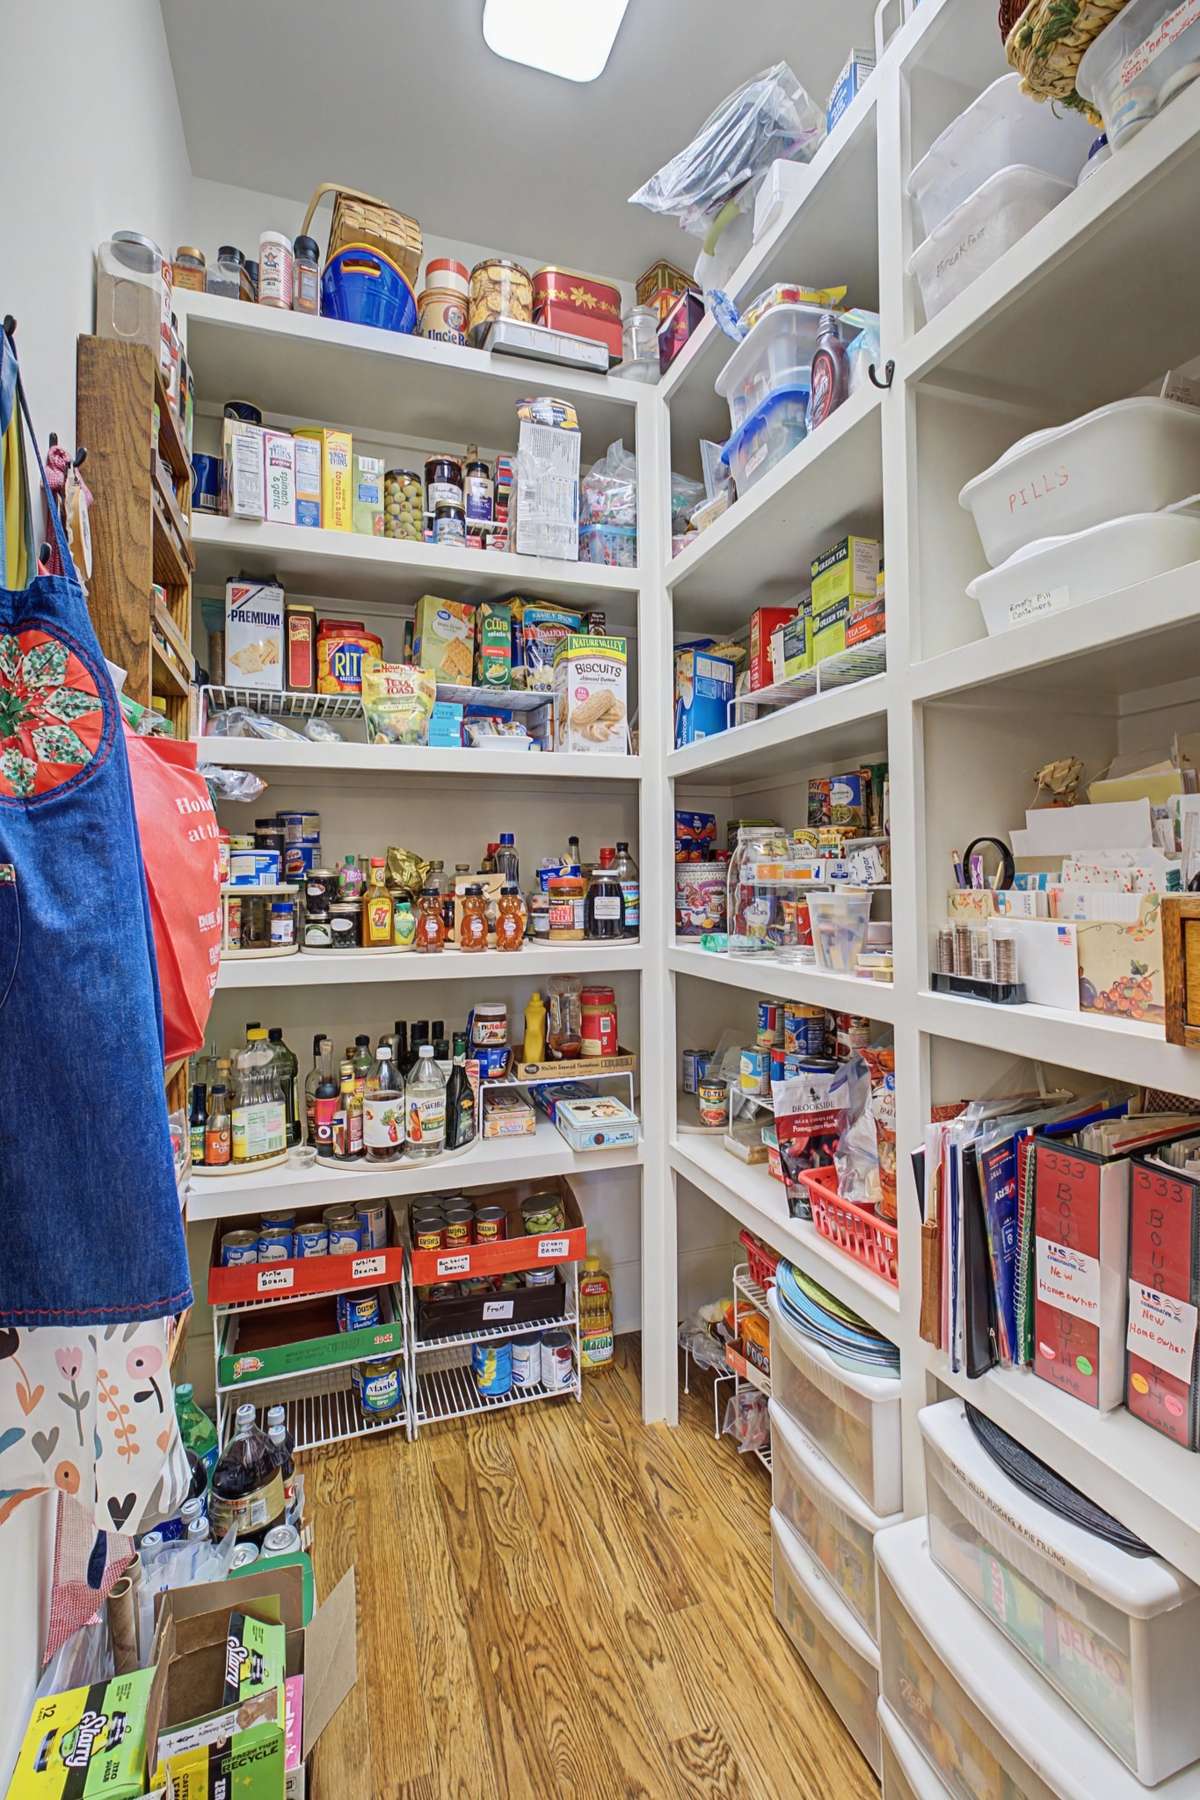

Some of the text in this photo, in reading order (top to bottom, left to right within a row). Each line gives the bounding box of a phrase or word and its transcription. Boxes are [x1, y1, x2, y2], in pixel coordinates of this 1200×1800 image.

[1009, 465, 1069, 512] PILLS
[231, 609, 280, 627] PREMIUM
[335, 652, 364, 677] RIT
[792, 1101, 834, 1112] BROOKSIDE
[1043, 1153, 1087, 1180] 333
[1137, 1171, 1184, 1203] 333
[1051, 1266, 1073, 1281] New
[1039, 1278, 1098, 1309] Homeowner
[1142, 1308, 1165, 1327] New
[225, 1636, 248, 1689] Starry
[43, 1704, 57, 1720] 12
[64, 1711, 109, 1767] Starry
[221, 1745, 280, 1775] RECYCLE
